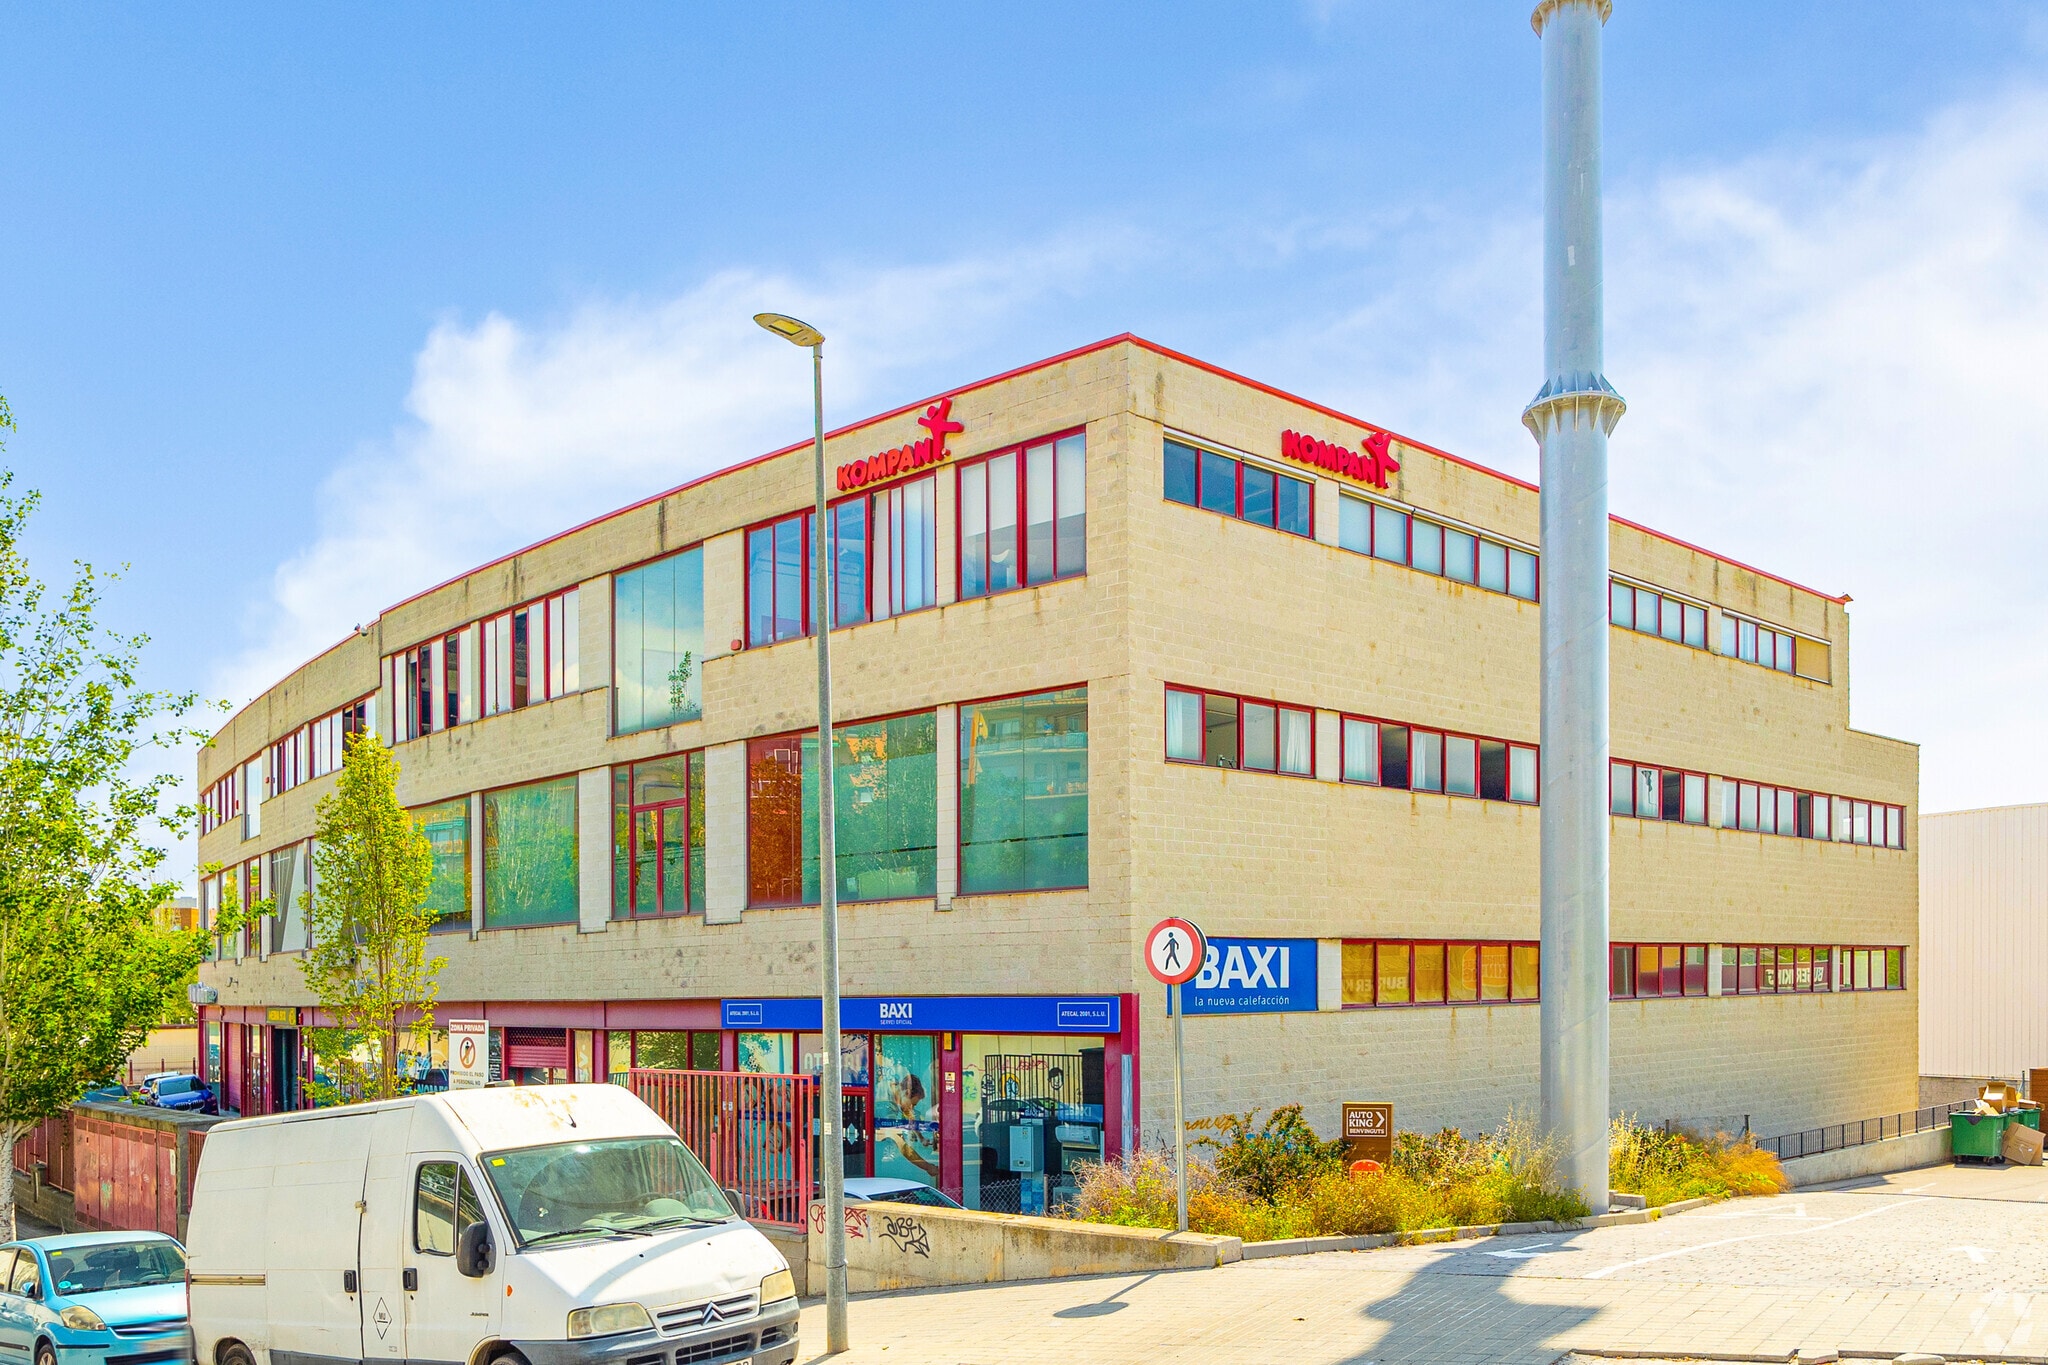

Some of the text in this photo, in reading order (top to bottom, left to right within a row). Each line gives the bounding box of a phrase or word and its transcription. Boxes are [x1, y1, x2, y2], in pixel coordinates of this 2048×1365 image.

[1195, 945, 1290, 989] BAXI
[1195, 994, 1290, 1006] la nueva calefacción
[879, 1003, 913, 1018] BAXI
[464, 1024, 485, 1032] PRIVADA
[1349, 1111, 1373, 1119] AUTO
[1349, 1119, 1373, 1127] KING
